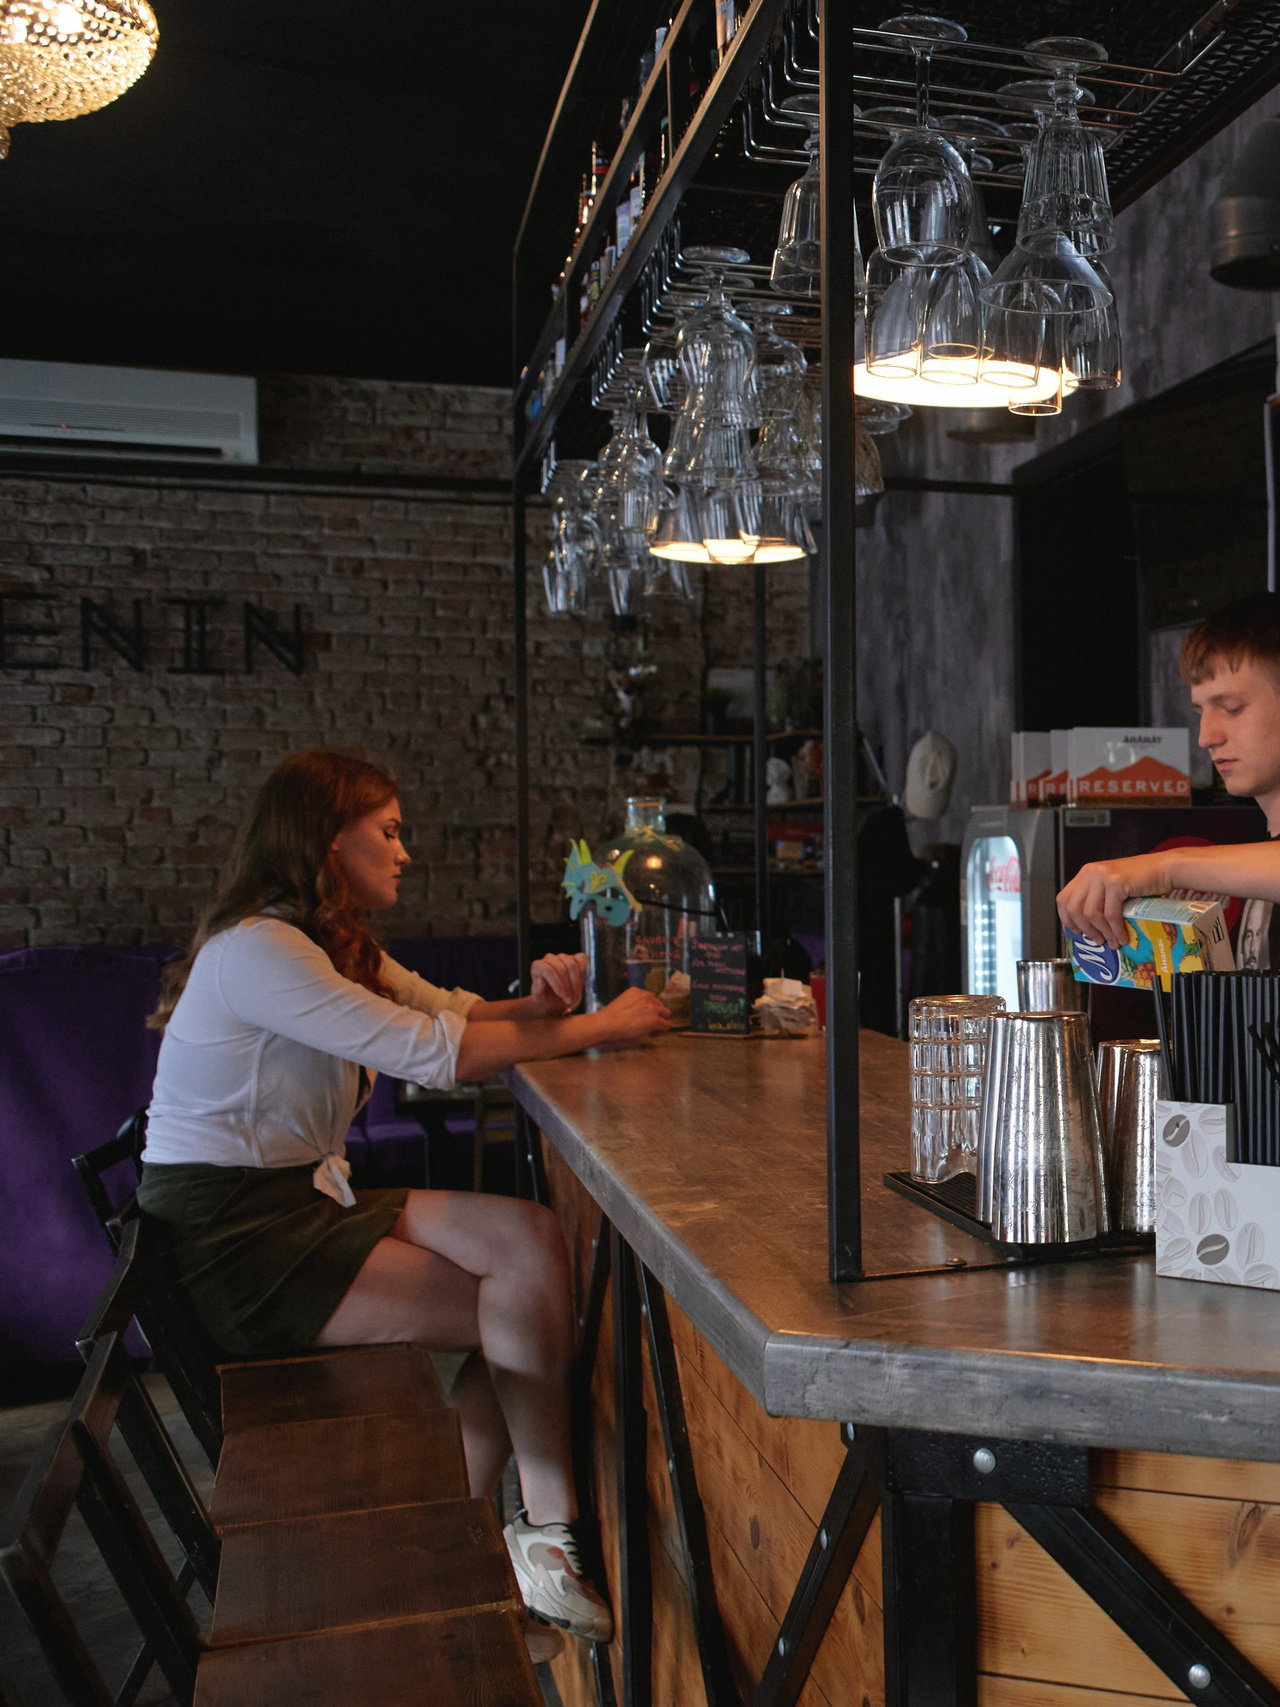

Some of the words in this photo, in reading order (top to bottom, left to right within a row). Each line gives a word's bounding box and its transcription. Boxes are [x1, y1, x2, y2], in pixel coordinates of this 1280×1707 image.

[1123, 735, 1162, 744] ARARAT
[1079, 780, 1189, 793] RESERVED
[1157, 938, 1169, 973] Ананас
